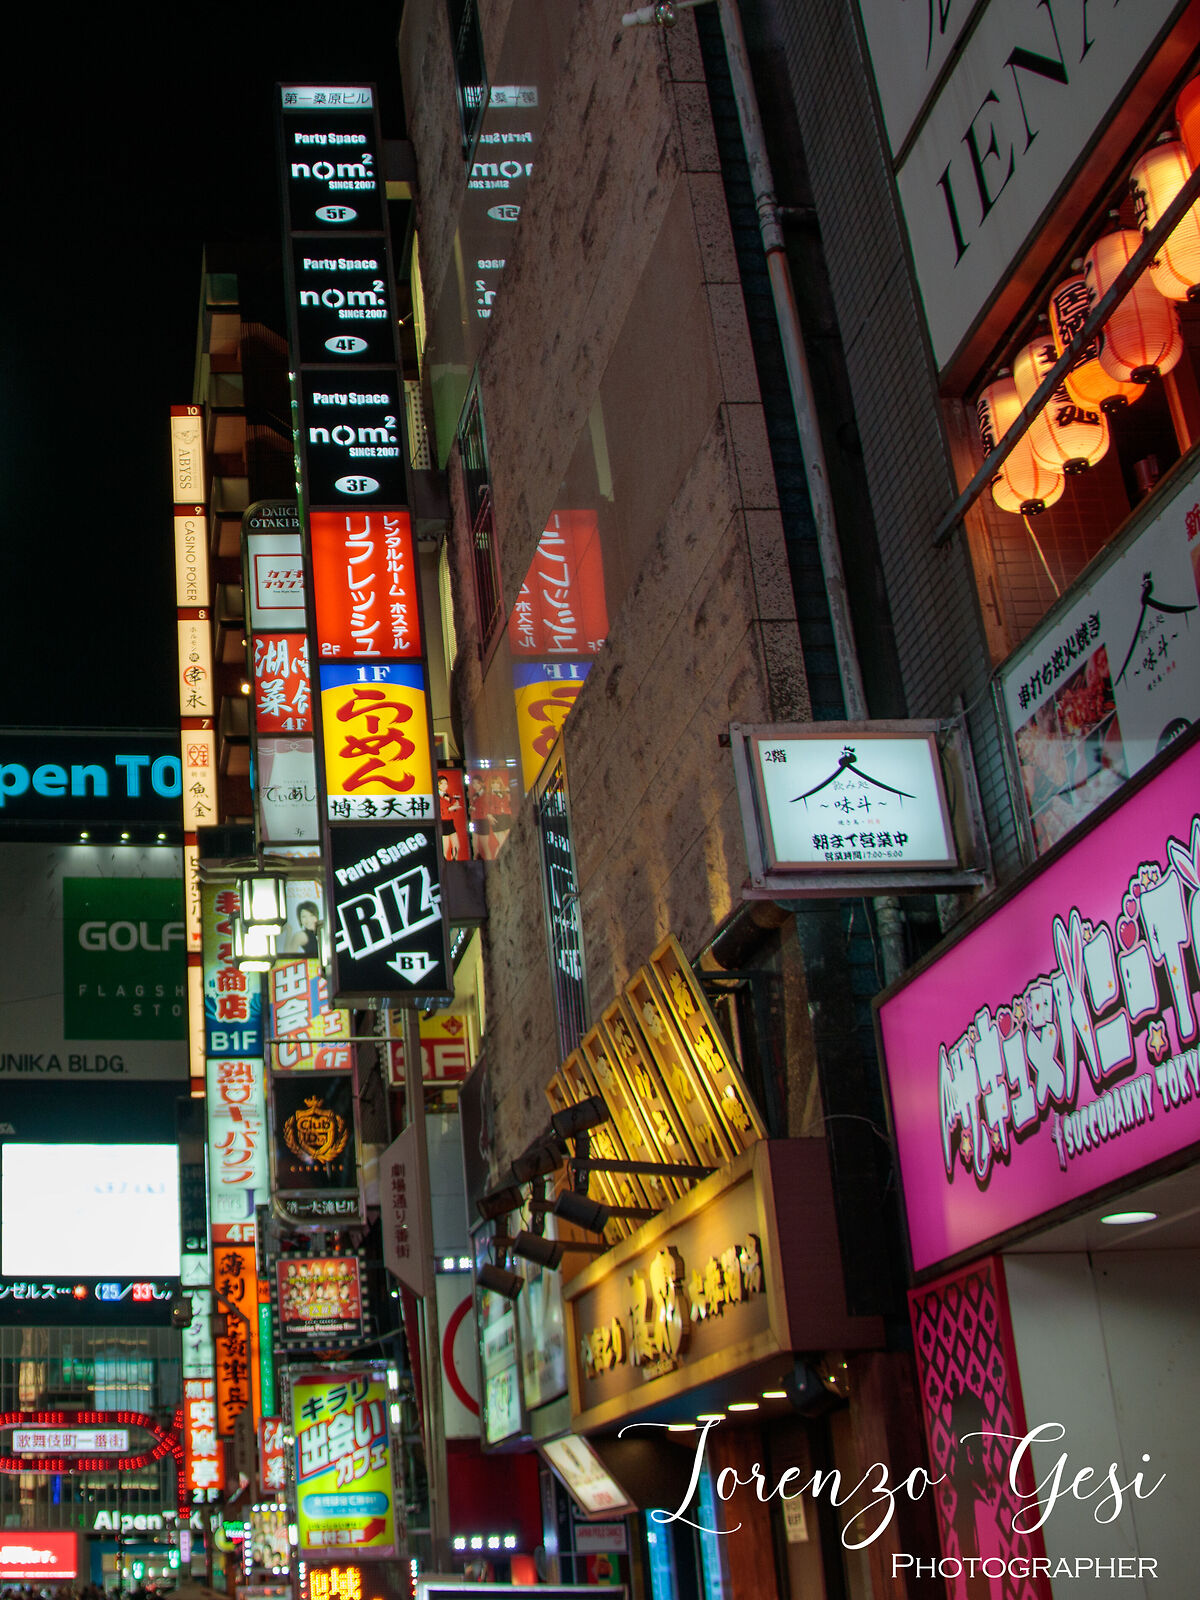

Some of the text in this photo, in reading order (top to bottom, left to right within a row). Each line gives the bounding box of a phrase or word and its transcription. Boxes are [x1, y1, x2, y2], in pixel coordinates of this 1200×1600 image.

[284, 91, 371, 105] 第一桑原ビル
[294, 132, 367, 145] Party Space
[328, 180, 376, 190] SINCE 2007
[326, 208, 347, 219] 5F
[303, 258, 378, 271] Party Space
[338, 309, 387, 318] SINCE 2007
[336, 338, 357, 350] 4F
[312, 392, 389, 406] Party Space
[186, 406, 198, 416] 10
[349, 447, 399, 457] SINCE 2007
[178, 447, 193, 491] ABYSS
[345, 479, 367, 492] 3F
[194, 505, 202, 516] 9
[262, 507, 298, 517] DAIIC
[183, 519, 198, 602] CASINO POKER
[383, 514, 406, 596] レンタルルーム
[345, 514, 380, 655] リフレッシュ
[198, 609, 206, 620] 8
[390, 601, 410, 650] ホステル
[321, 642, 341, 656] 2F
[356, 665, 391, 682] 1F
[201, 718, 209, 729] 7
[280, 716, 308, 731] 4F
[764, 749, 788, 765] 2階
[189, 781, 212, 818] 魚金
[330, 796, 430, 819] 博多天神
[812, 831, 909, 850] 朝まで営業中
[335, 831, 428, 888] Party Space
[337, 864, 443, 961] RIZ
[79, 920, 185, 952] GOLF
[400, 955, 429, 970] B1
[273, 960, 313, 1068] 出会い
[211, 1030, 258, 1051] B1F
[69, 1054, 129, 1074] BLDG.
[322, 1051, 349, 1068] 1F
[300, 1119, 331, 1131] Club
[225, 1225, 255, 1241] 4F
[300, 1374, 370, 1421] キラリ
[16, 1433, 125, 1449] 歌舞伎町一番街
[299, 1398, 386, 1476] 出会い
[336, 1444, 387, 1489] カフェ
[93, 1510, 161, 1531] Alpen
